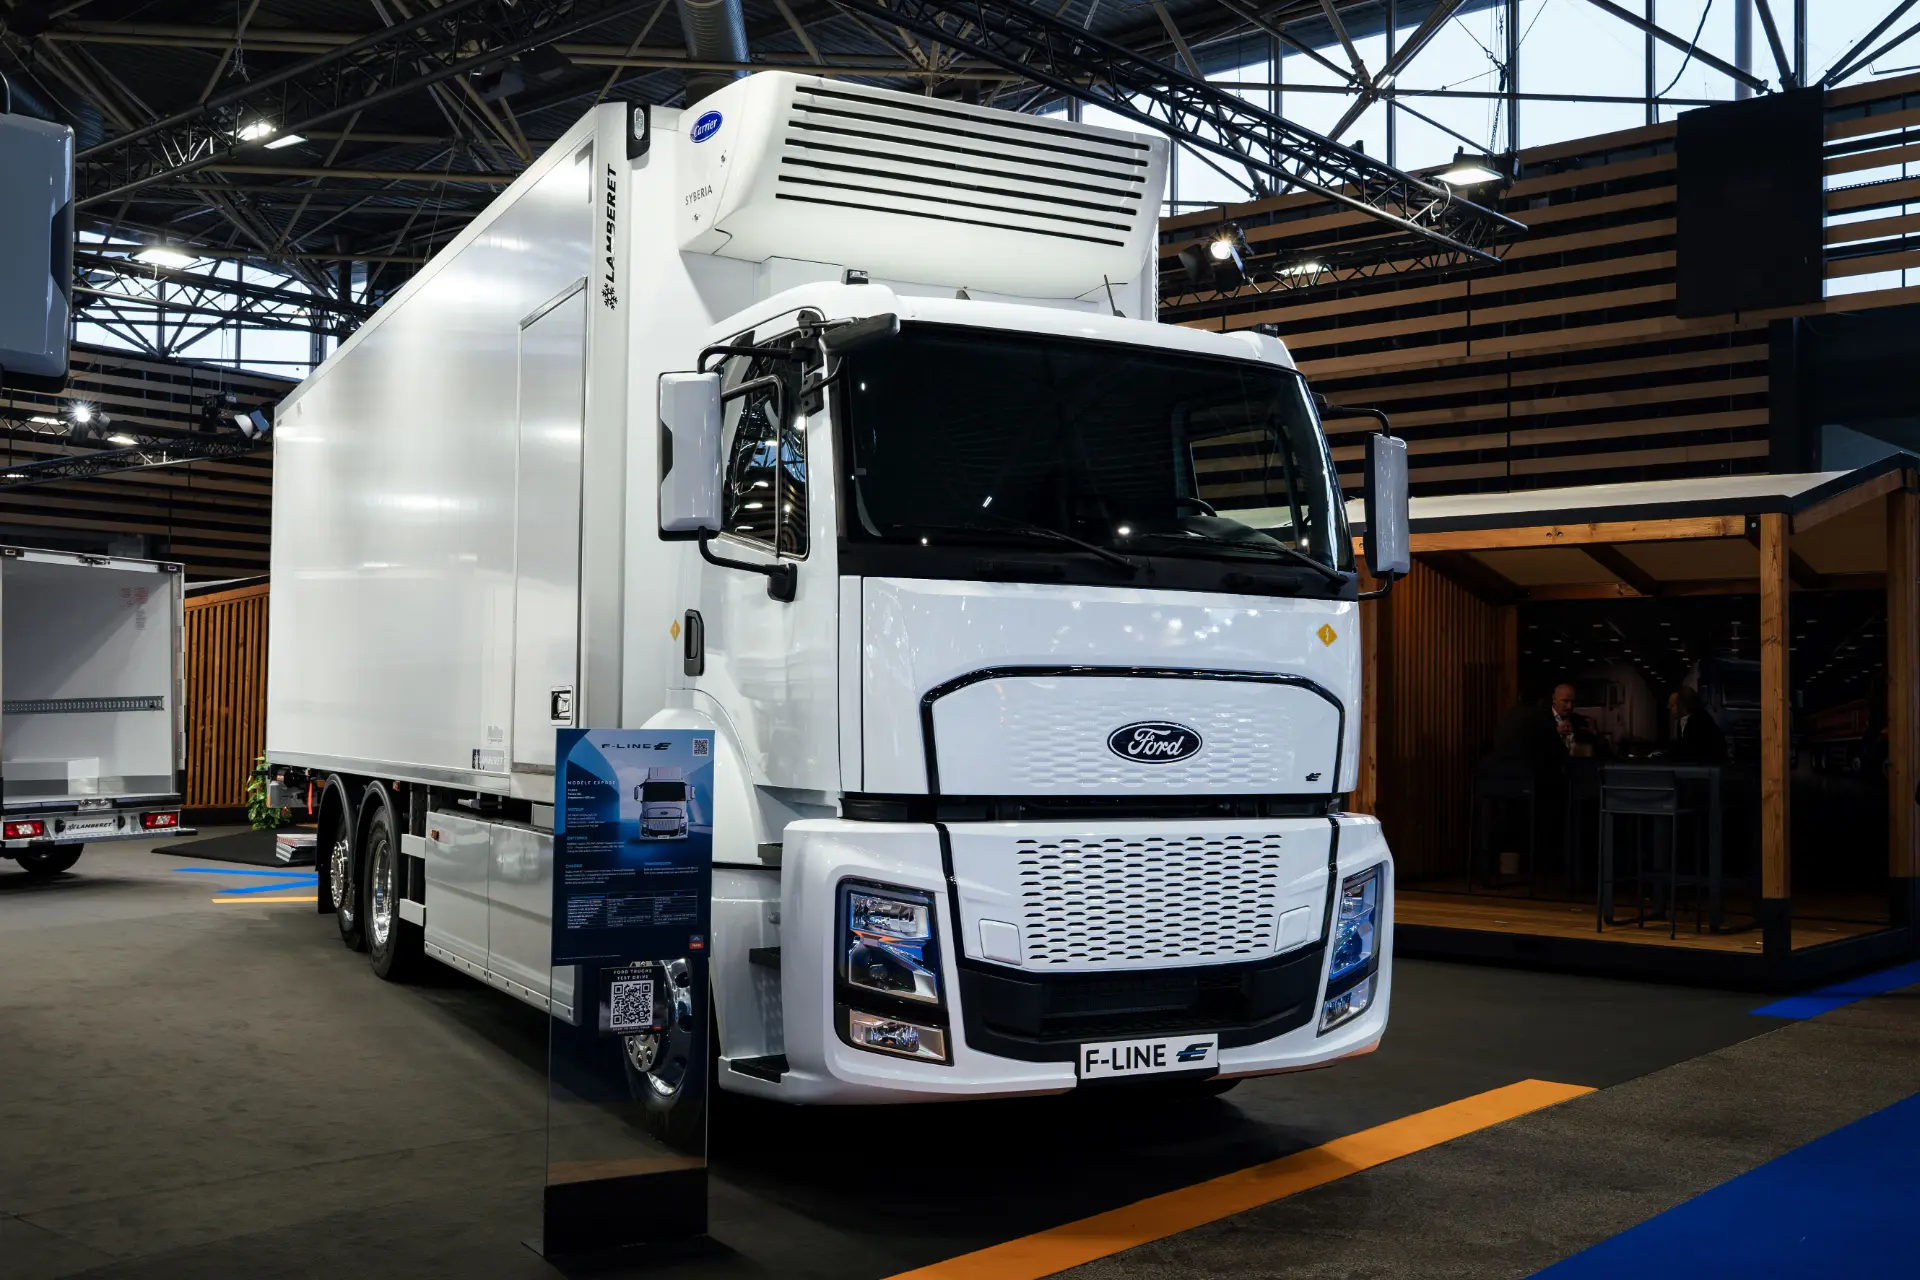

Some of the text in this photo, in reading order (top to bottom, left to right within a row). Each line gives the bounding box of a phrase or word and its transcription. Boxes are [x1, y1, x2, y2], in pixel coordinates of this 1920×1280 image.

[693, 118, 718, 138] Carrier
[685, 184, 713, 206] SYBERIA
[605, 163, 617, 283] LAMBERET
[1127, 728, 1185, 757] Ford
[1085, 1043, 1167, 1073] F-LINE
